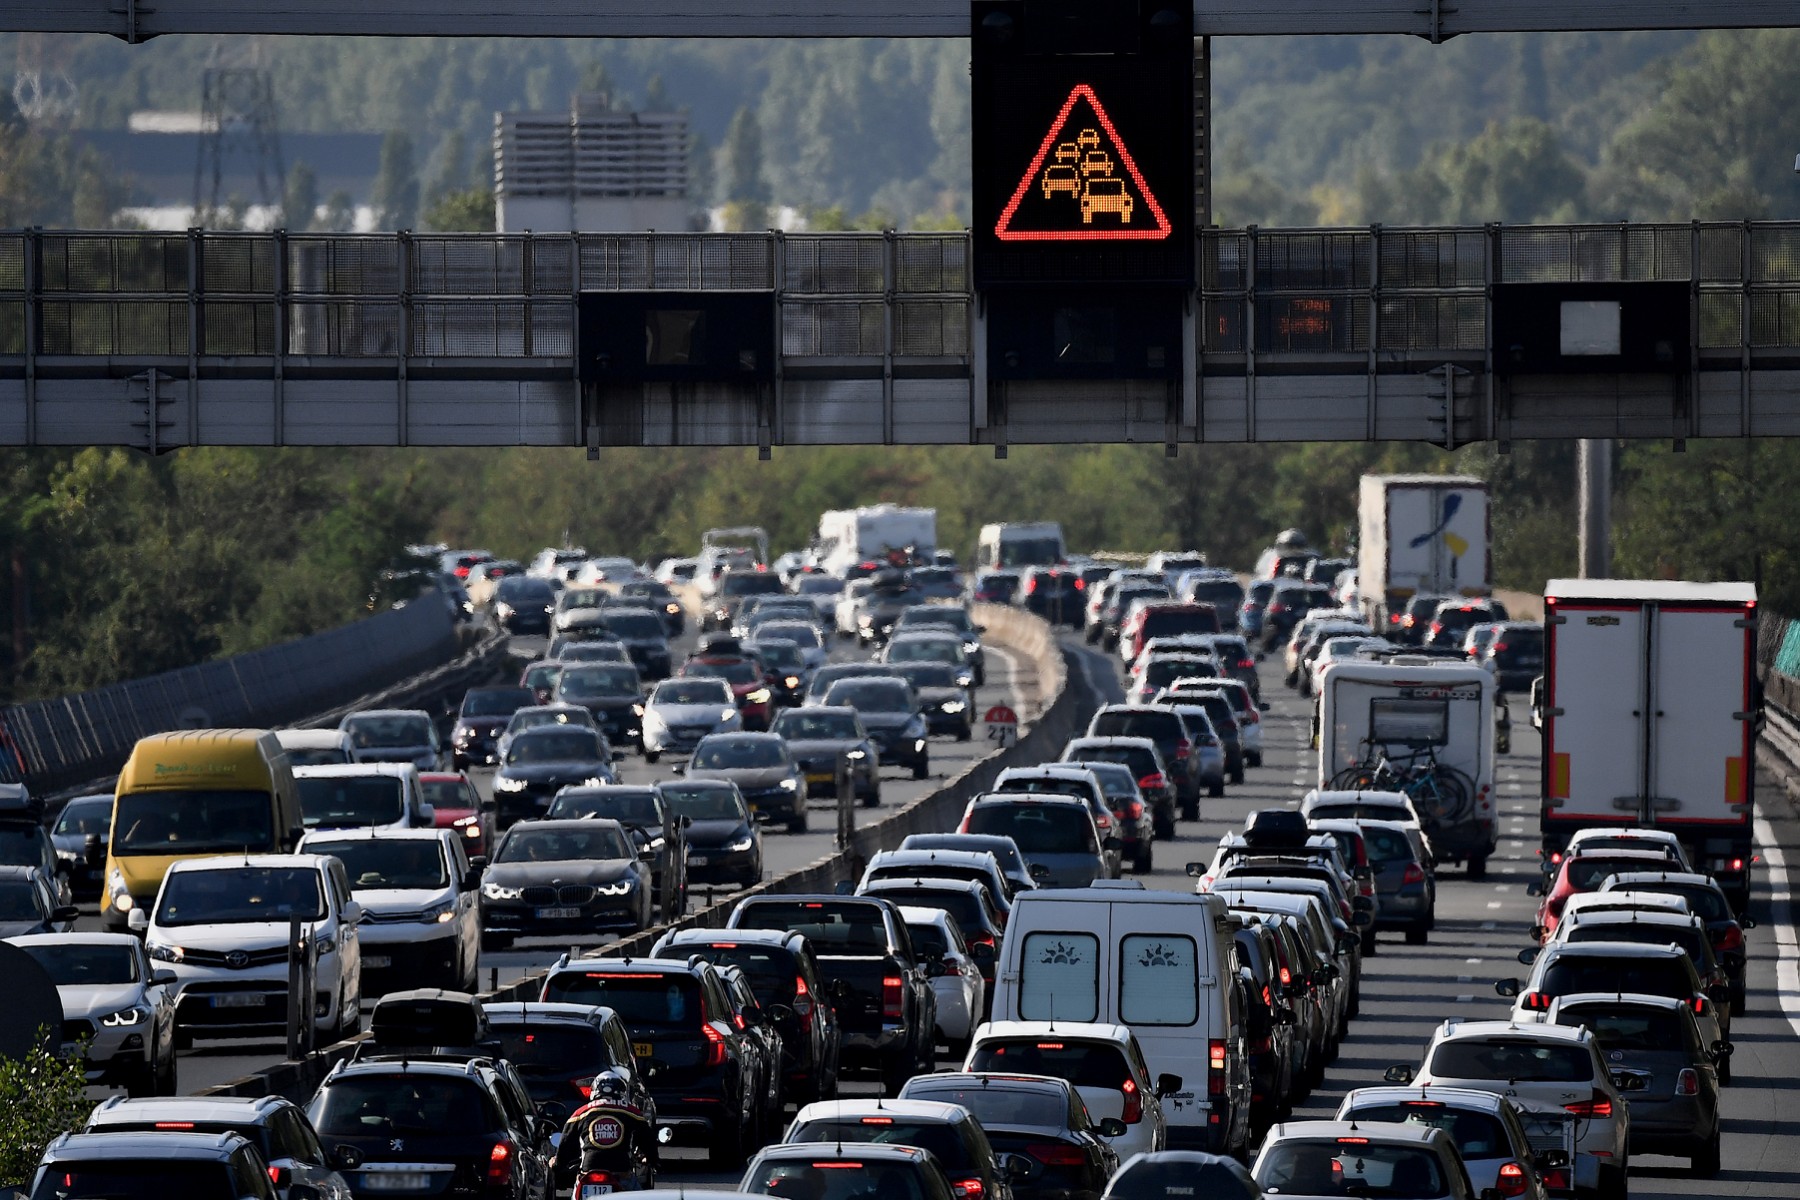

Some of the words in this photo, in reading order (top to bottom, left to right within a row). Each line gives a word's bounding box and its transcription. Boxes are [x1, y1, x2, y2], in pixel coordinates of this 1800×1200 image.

[1413, 688, 1477, 701] carthago
[594, 1123, 618, 1132] LUCKY
[594, 1131, 618, 1140] STRIKE
